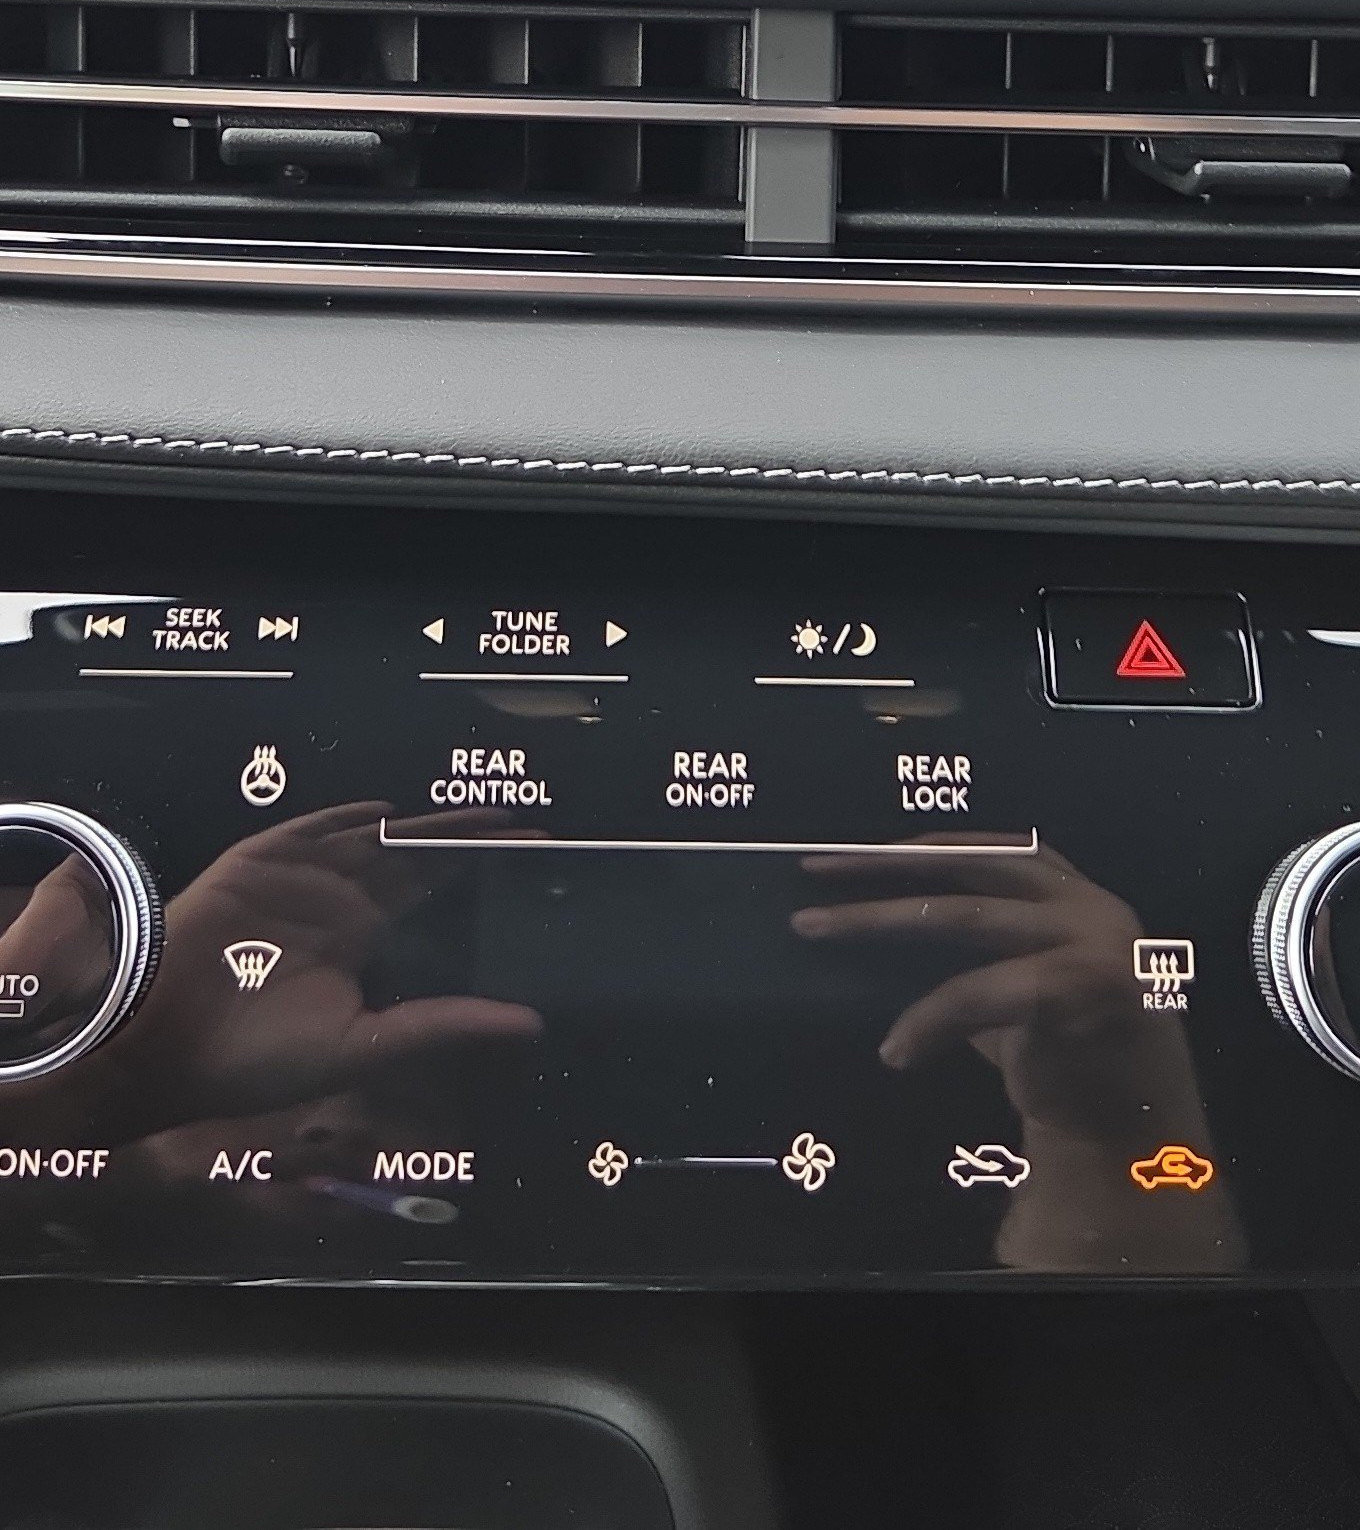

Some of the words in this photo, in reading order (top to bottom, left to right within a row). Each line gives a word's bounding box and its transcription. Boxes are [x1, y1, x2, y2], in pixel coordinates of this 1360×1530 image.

[165, 607, 223, 628] SEEK
[491, 610, 559, 633] TUNE
[152, 629, 230, 652] TRACK
[478, 633, 570, 656] FOLDER
[450, 748, 527, 777] REAR
[673, 751, 749, 780] REAR
[897, 754, 973, 783] REAR
[429, 779, 552, 806] CONTROL
[901, 785, 969, 813] LOCK
[1142, 992, 1189, 1010] REAR
[208, 1150, 274, 1181] A/C
[372, 1151, 476, 1183] MODE
